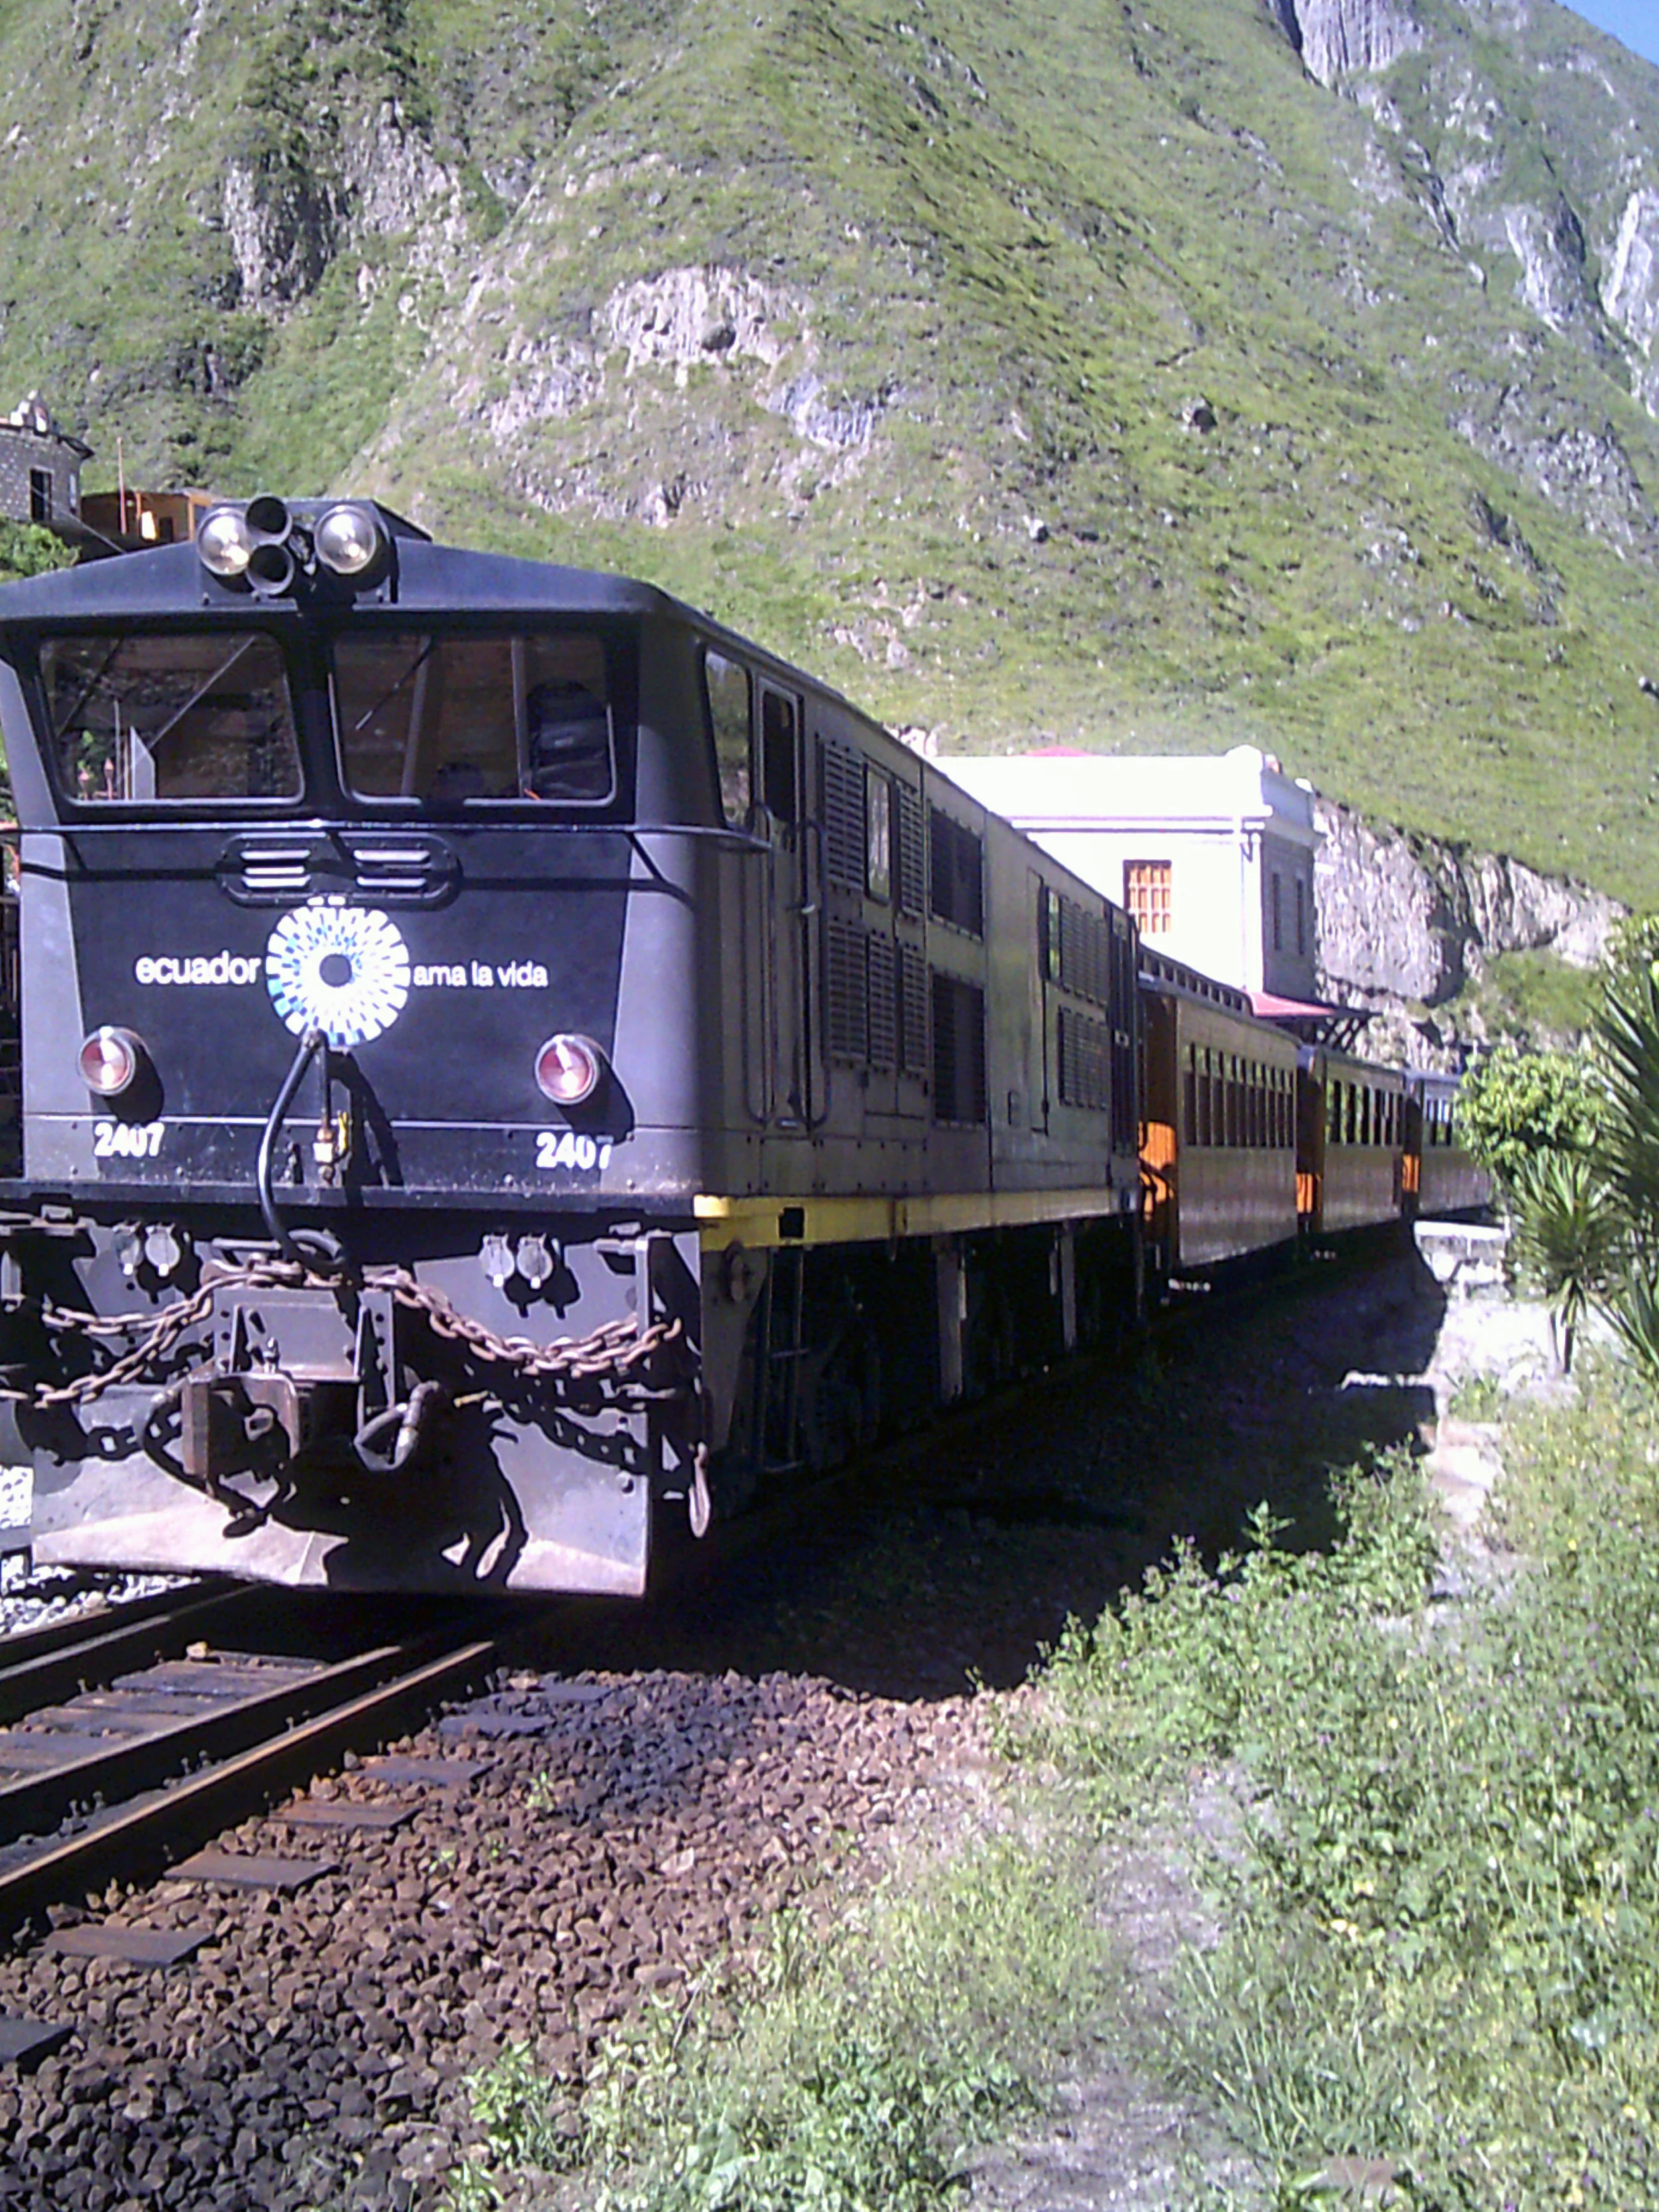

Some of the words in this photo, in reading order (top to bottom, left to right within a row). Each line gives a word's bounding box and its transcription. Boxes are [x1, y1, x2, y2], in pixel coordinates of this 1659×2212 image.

[135, 950, 262, 984] ecuador
[413, 965, 467, 987] ama
[471, 960, 494, 987] la
[497, 960, 549, 988] vida
[94, 1122, 165, 1157] 2407
[536, 1132, 614, 1170] 2407
